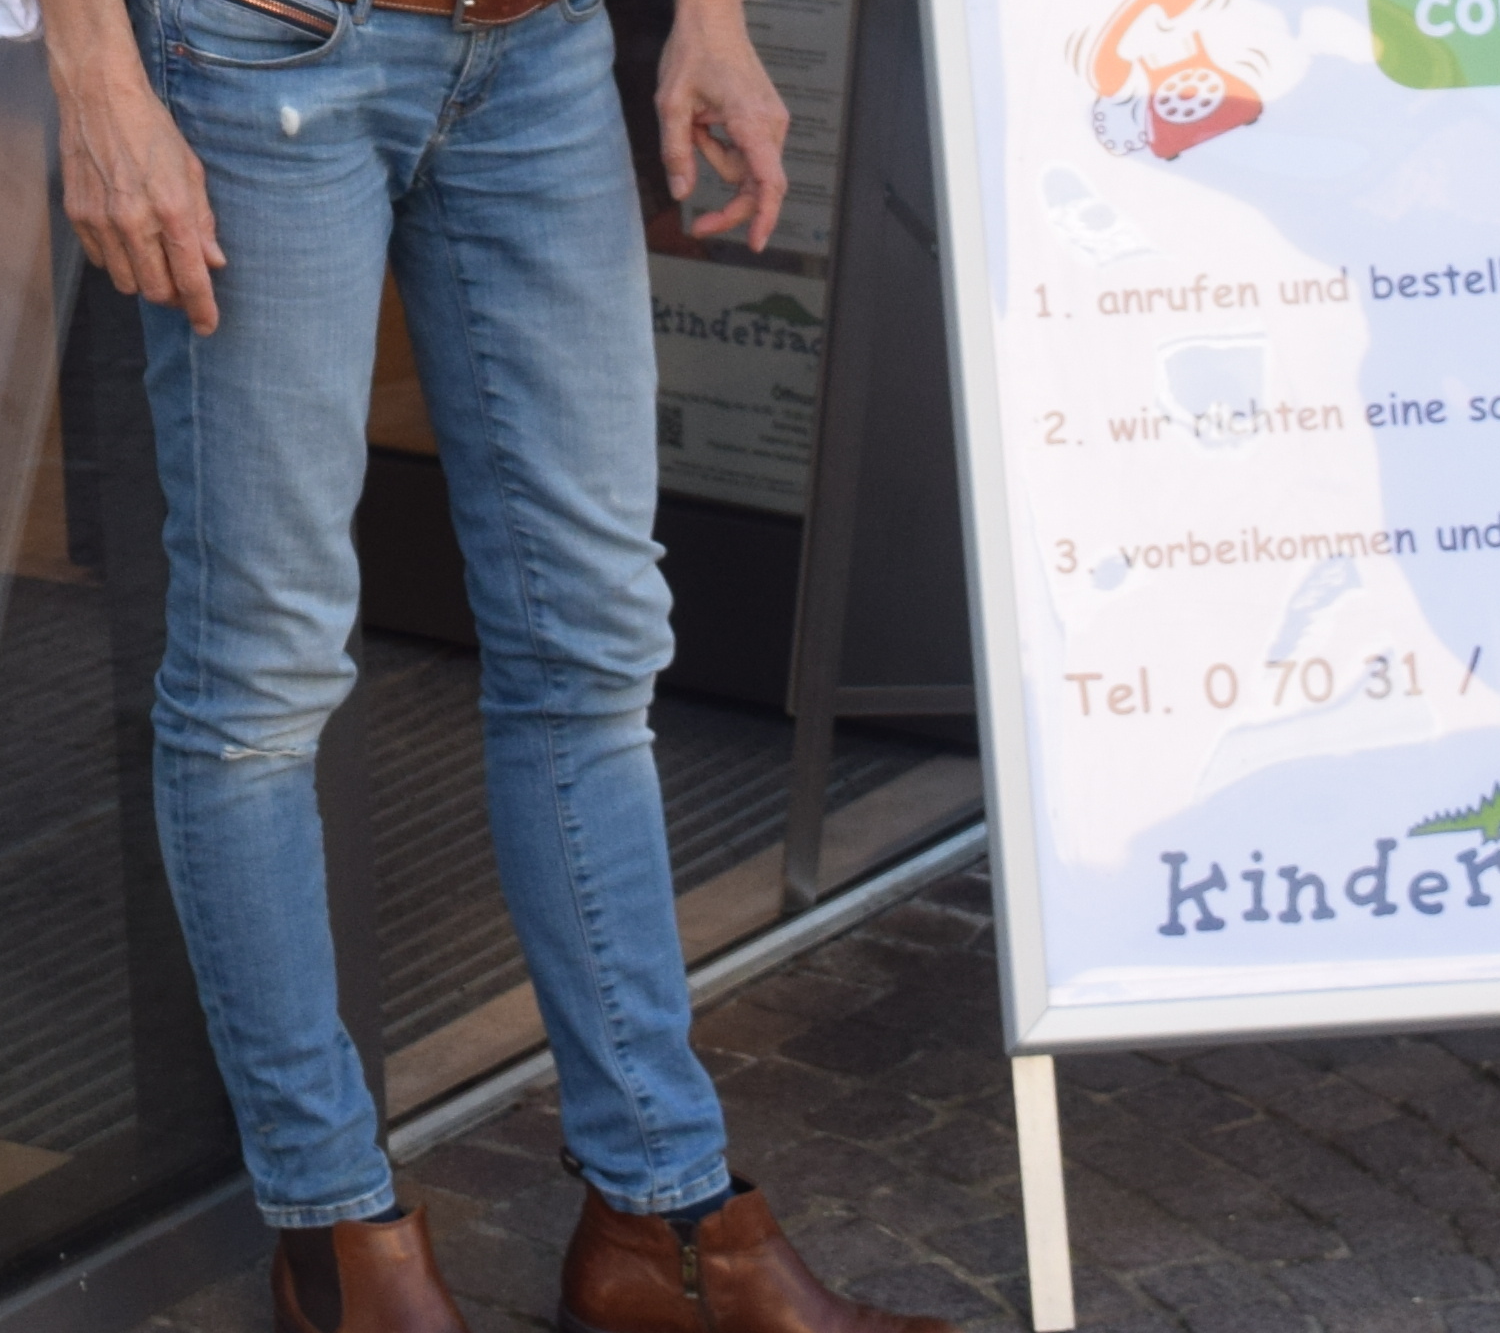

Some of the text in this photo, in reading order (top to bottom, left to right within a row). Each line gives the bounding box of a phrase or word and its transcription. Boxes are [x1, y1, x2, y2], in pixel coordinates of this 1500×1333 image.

[1033, 283, 1073, 320] 1.
[1097, 274, 1259, 317] anrufen
[1279, 267, 1350, 305] und
[1042, 411, 1086, 447] 2.
[1107, 406, 1173, 443] wir
[1192, 398, 1345, 438] richten
[1365, 391, 1448, 428] eine
[1054, 537, 1096, 576] 3.
[1119, 525, 1417, 572] vorbeikommen
[1065, 667, 1173, 717] Tel.
[1203, 663, 1239, 711] 0
[1265, 656, 1335, 707] 70
[1364, 651, 1424, 699] 31
[1458, 645, 1482, 696] /
